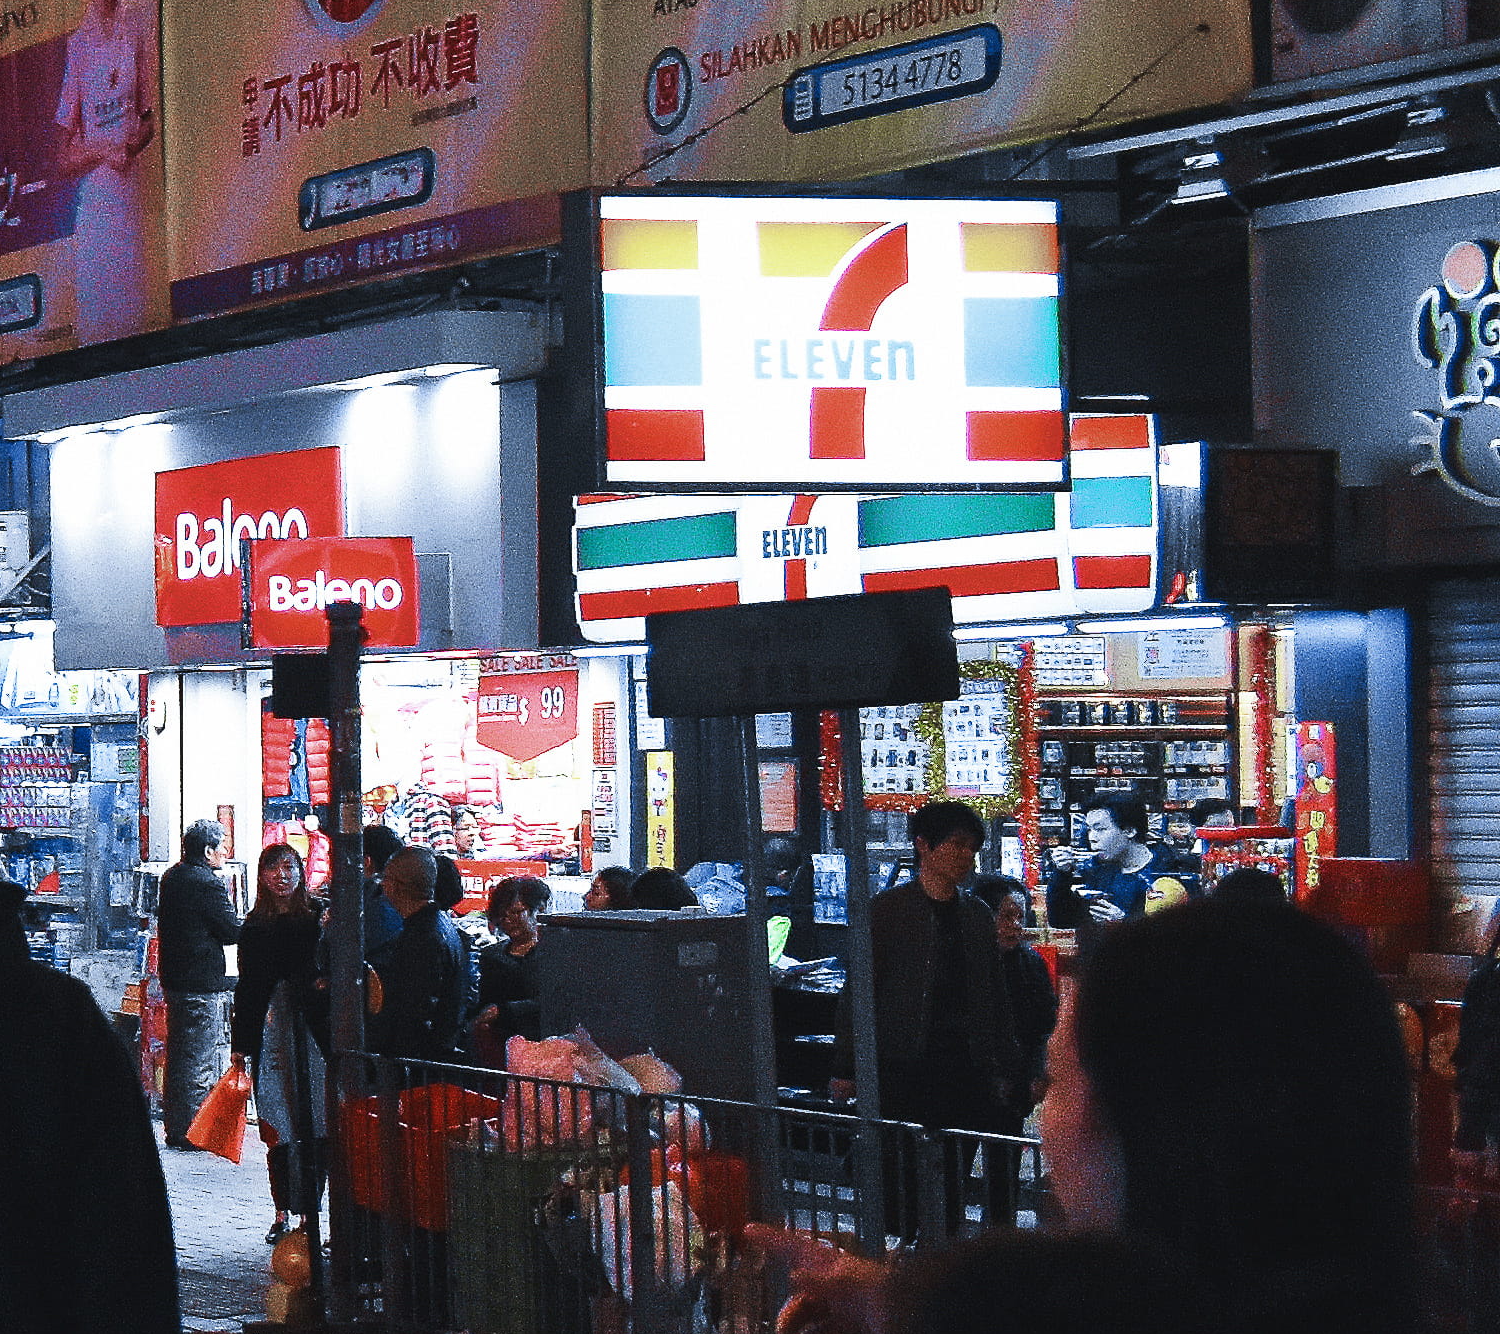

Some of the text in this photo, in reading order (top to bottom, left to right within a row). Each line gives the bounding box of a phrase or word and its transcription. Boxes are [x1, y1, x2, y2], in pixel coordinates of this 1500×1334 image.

[263, 55, 363, 142] 不成功
[371, 13, 479, 109] 不收費
[700, 30, 802, 84] SILAHKAN
[842, 49, 963, 108] 5134 4778
[268, 569, 403, 612] Baleno
[540, 685, 565, 720] 99
